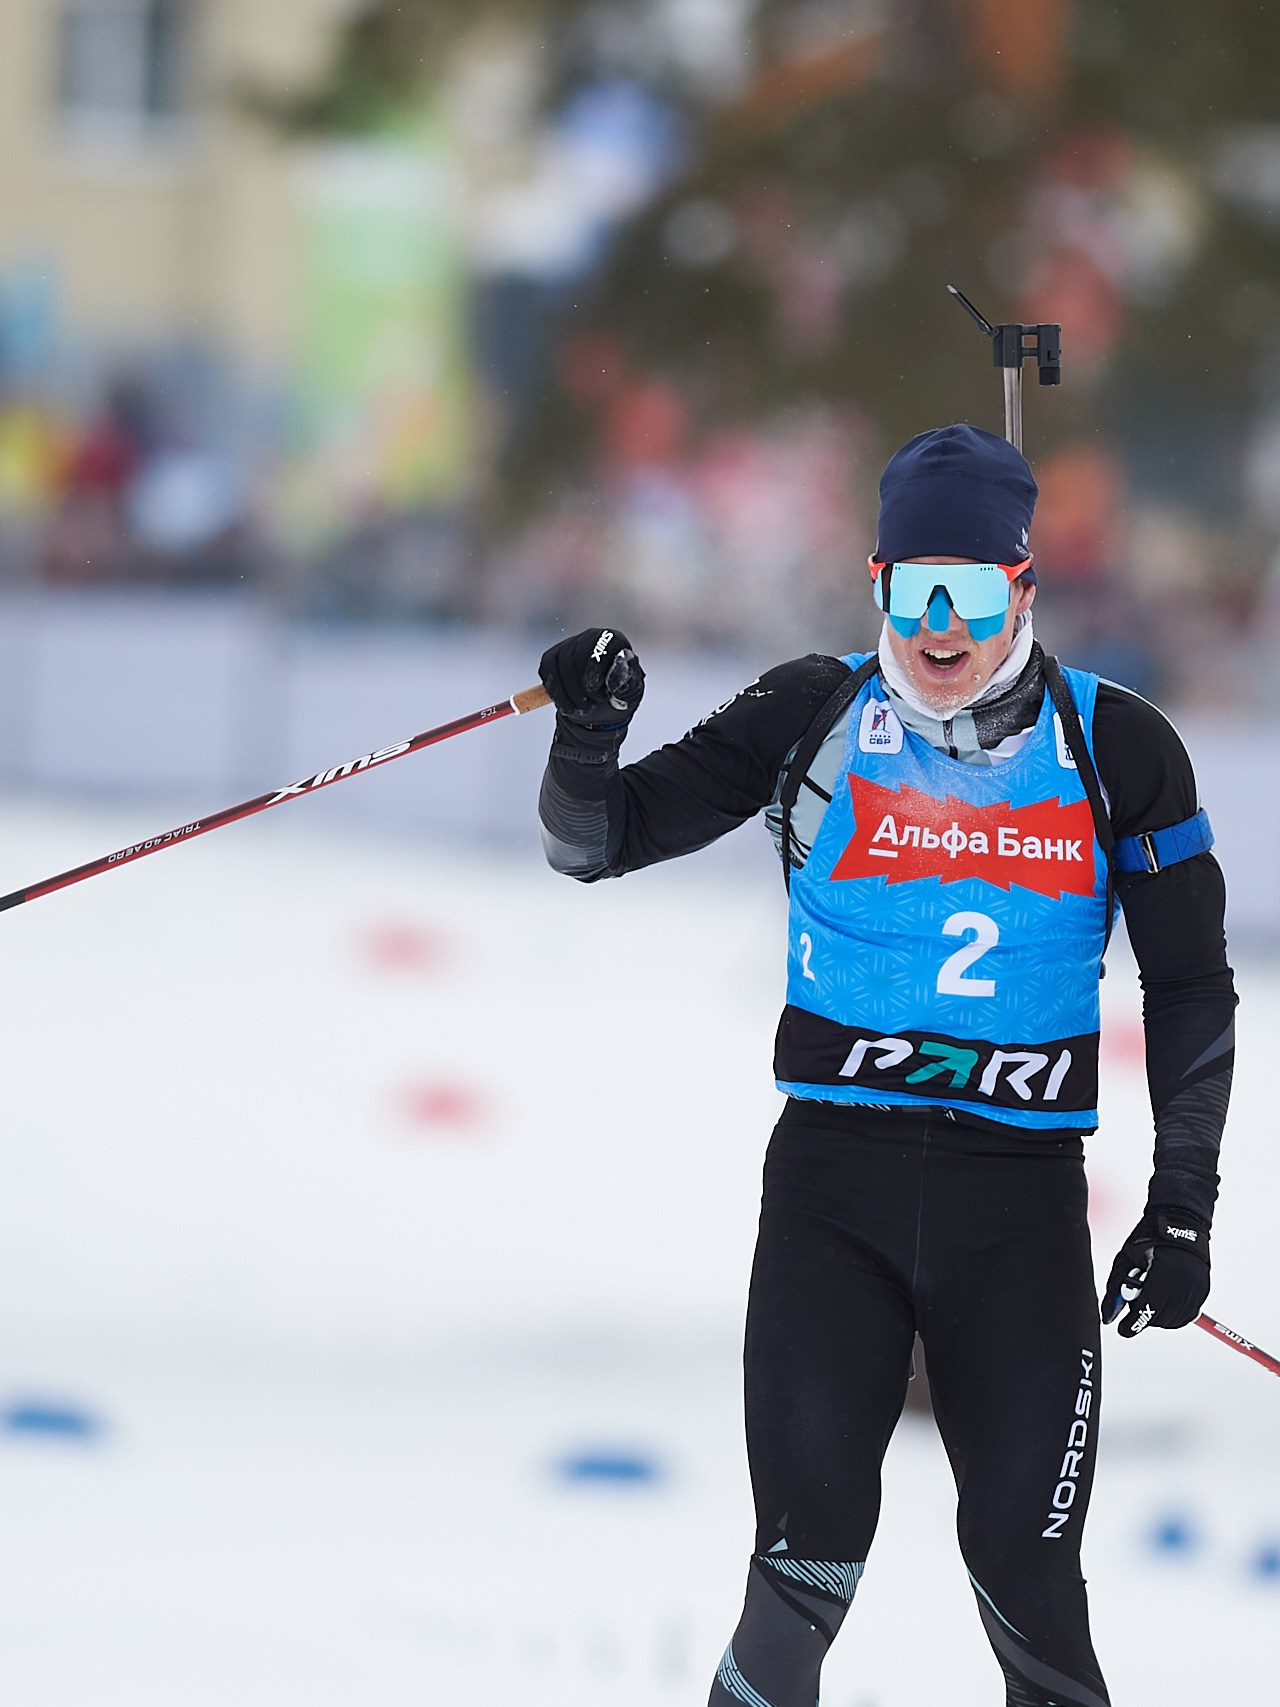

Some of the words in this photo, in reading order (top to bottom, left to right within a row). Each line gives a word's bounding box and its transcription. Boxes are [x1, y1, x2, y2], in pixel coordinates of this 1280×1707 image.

[108, 844, 144, 863] AERO
[164, 822, 201, 842] TRIAC
[869, 814, 989, 859] Альфа
[997, 826, 1083, 862] Банк
[800, 932, 816, 981] 2
[936, 911, 1000, 997] 2
[838, 1037, 1072, 1101] PARI
[1041, 1349, 1094, 1538] NORDSKI
